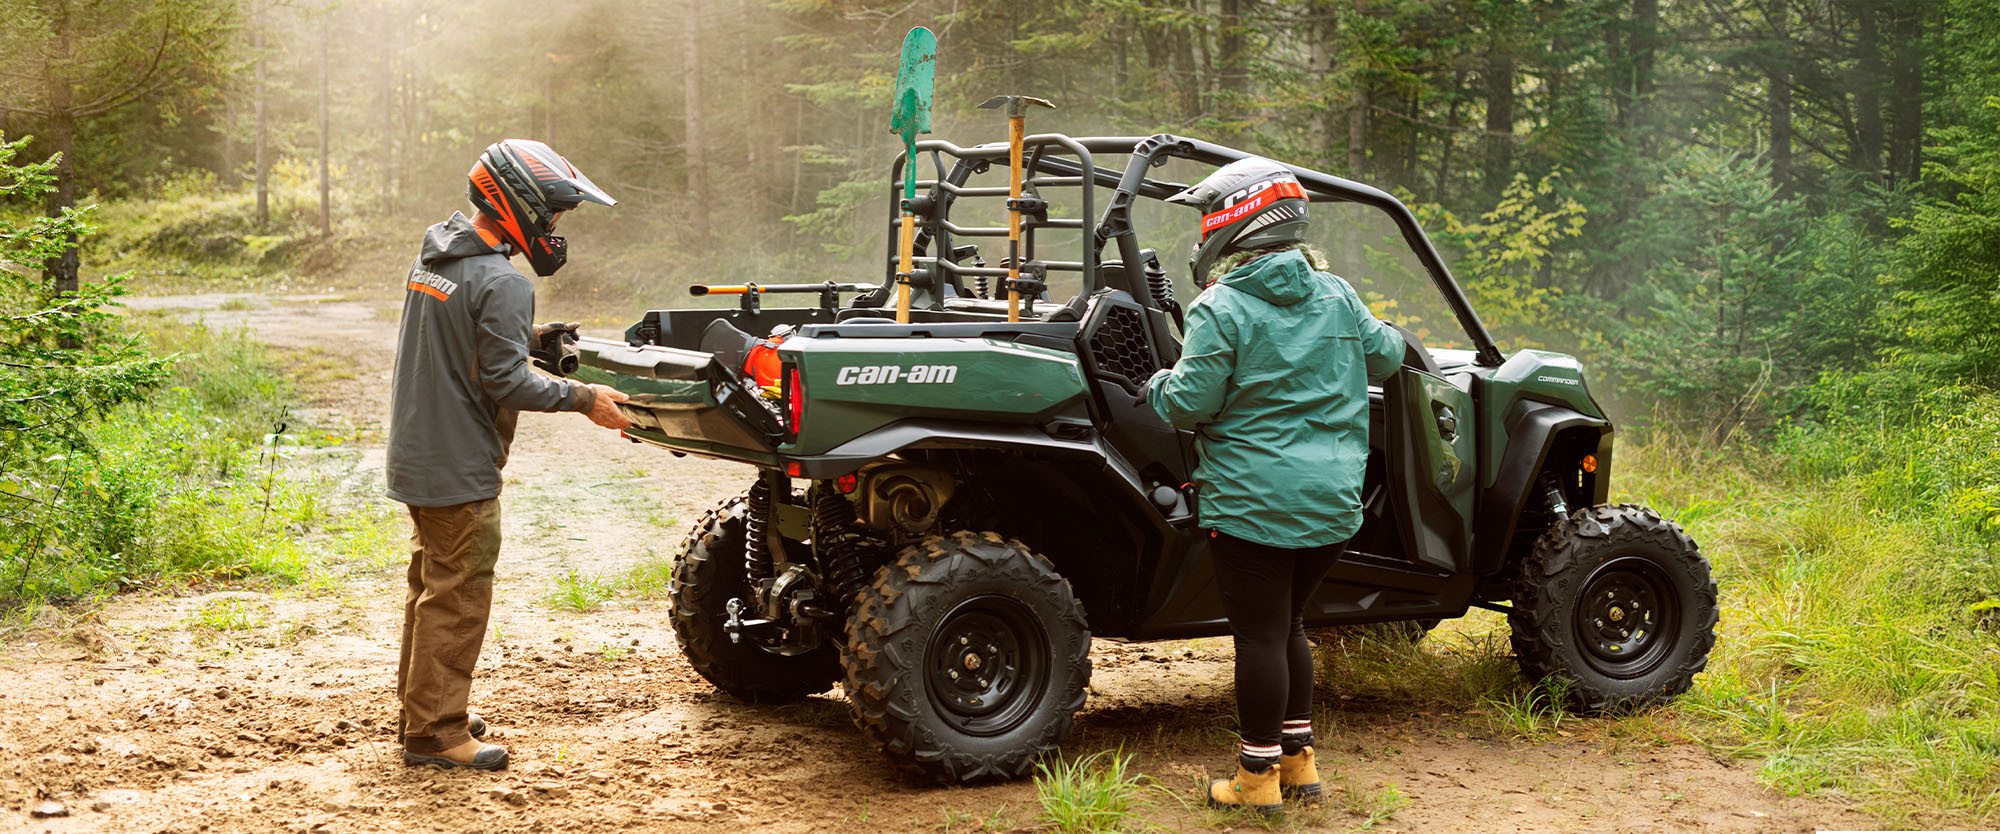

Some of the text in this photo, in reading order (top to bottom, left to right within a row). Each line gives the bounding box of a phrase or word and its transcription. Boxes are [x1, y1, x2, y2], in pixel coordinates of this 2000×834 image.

[1223, 177, 1294, 210] ca
[1206, 196, 1262, 228] can-am
[409, 269, 458, 296] canam
[836, 365, 957, 384] can-am
[1538, 375, 1578, 385] COMMANDER
